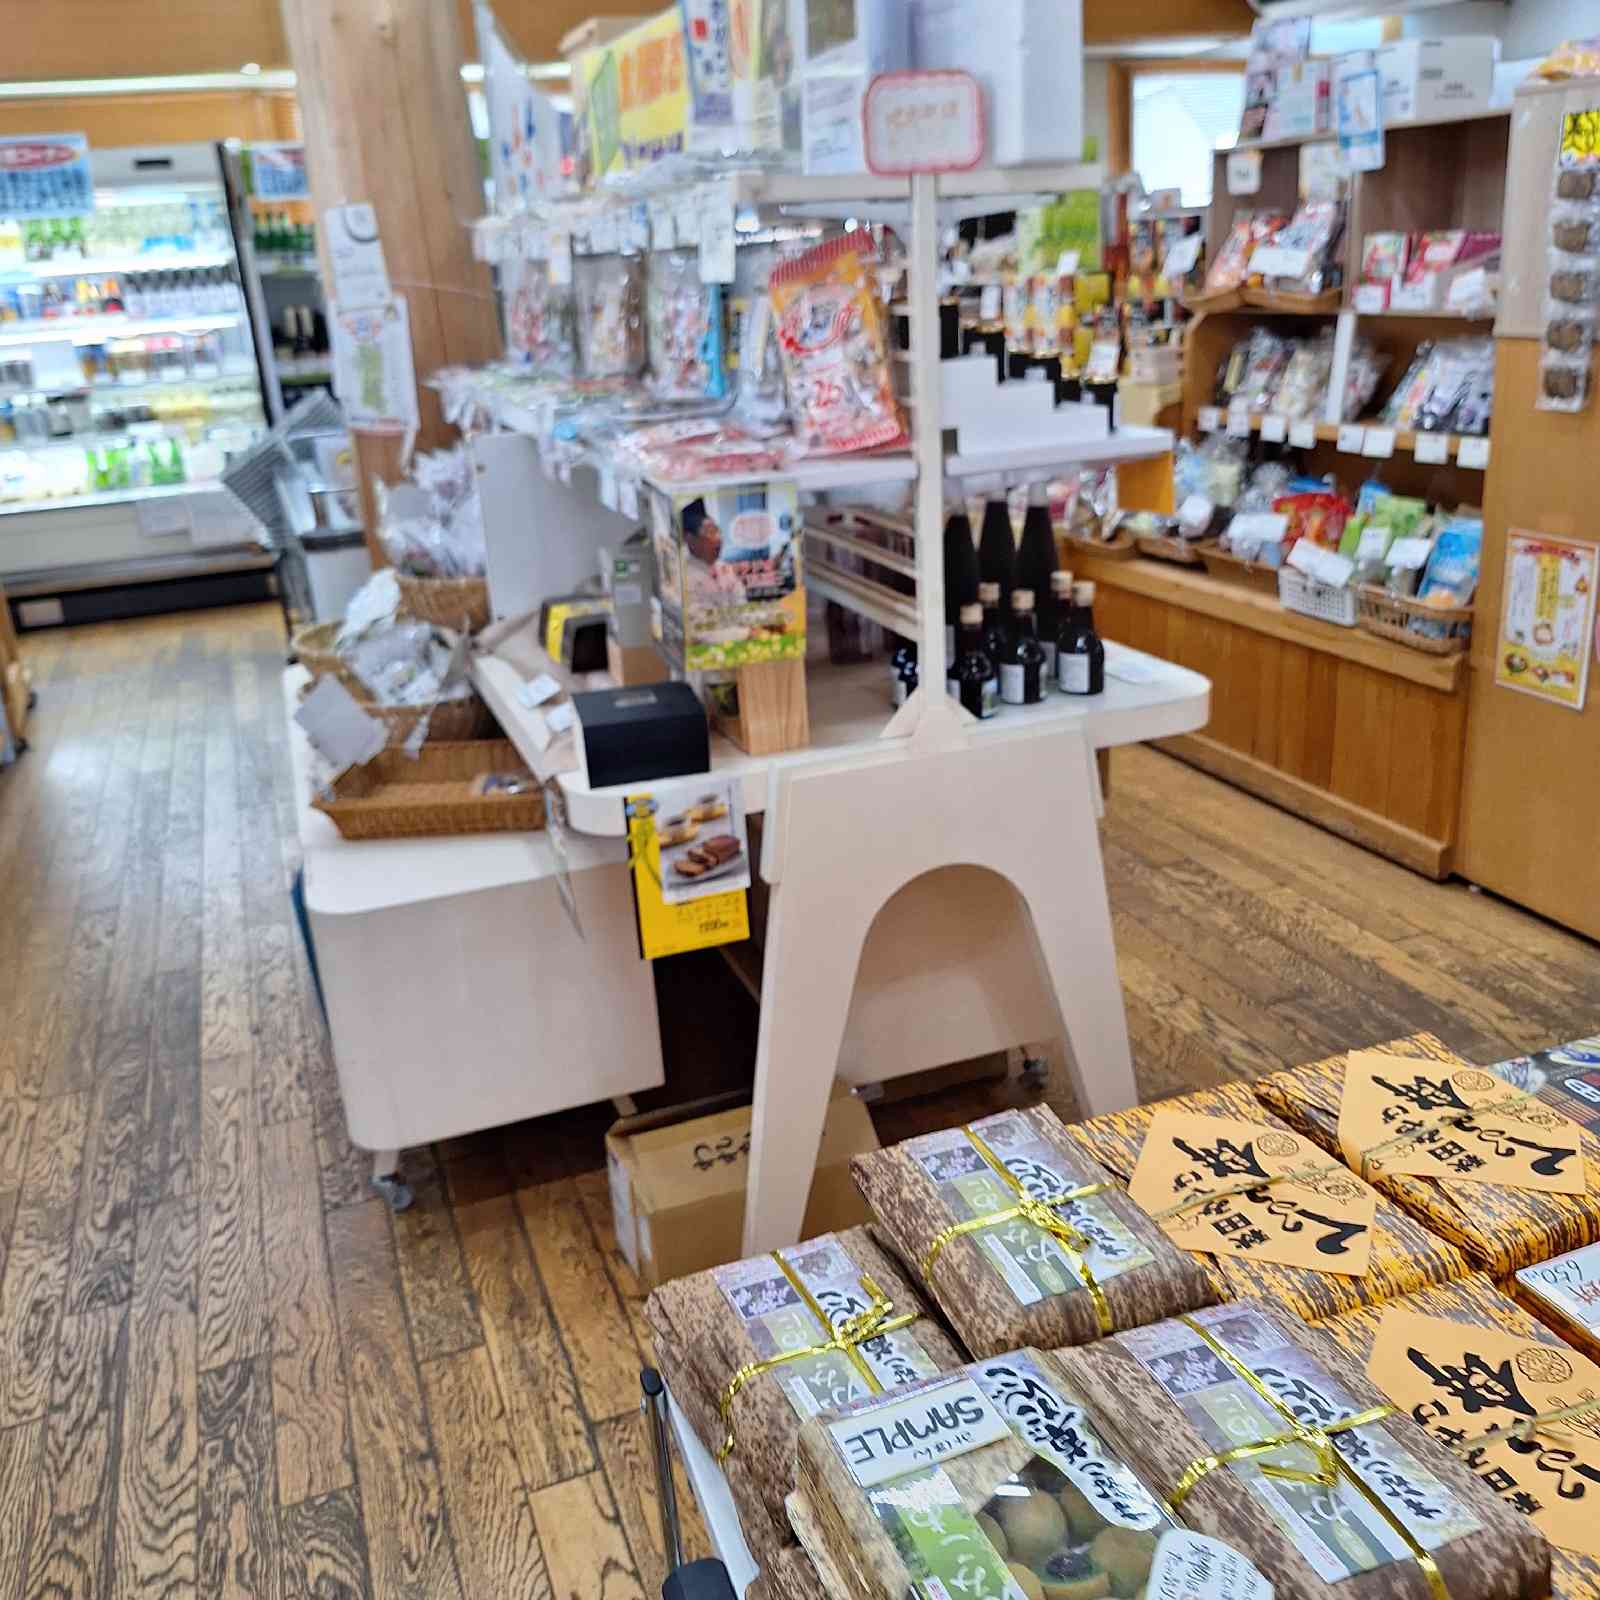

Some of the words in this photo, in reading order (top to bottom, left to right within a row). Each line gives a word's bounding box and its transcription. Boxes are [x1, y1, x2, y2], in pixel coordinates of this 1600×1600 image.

[1381, 1105, 1487, 1173] 秋田みやげ
[967, 1177, 1062, 1266] かみあに
[776, 1311, 862, 1409] かみあに
[844, 1395, 985, 1465] SAMPLE
[1407, 1347, 1600, 1500] るみ餅
